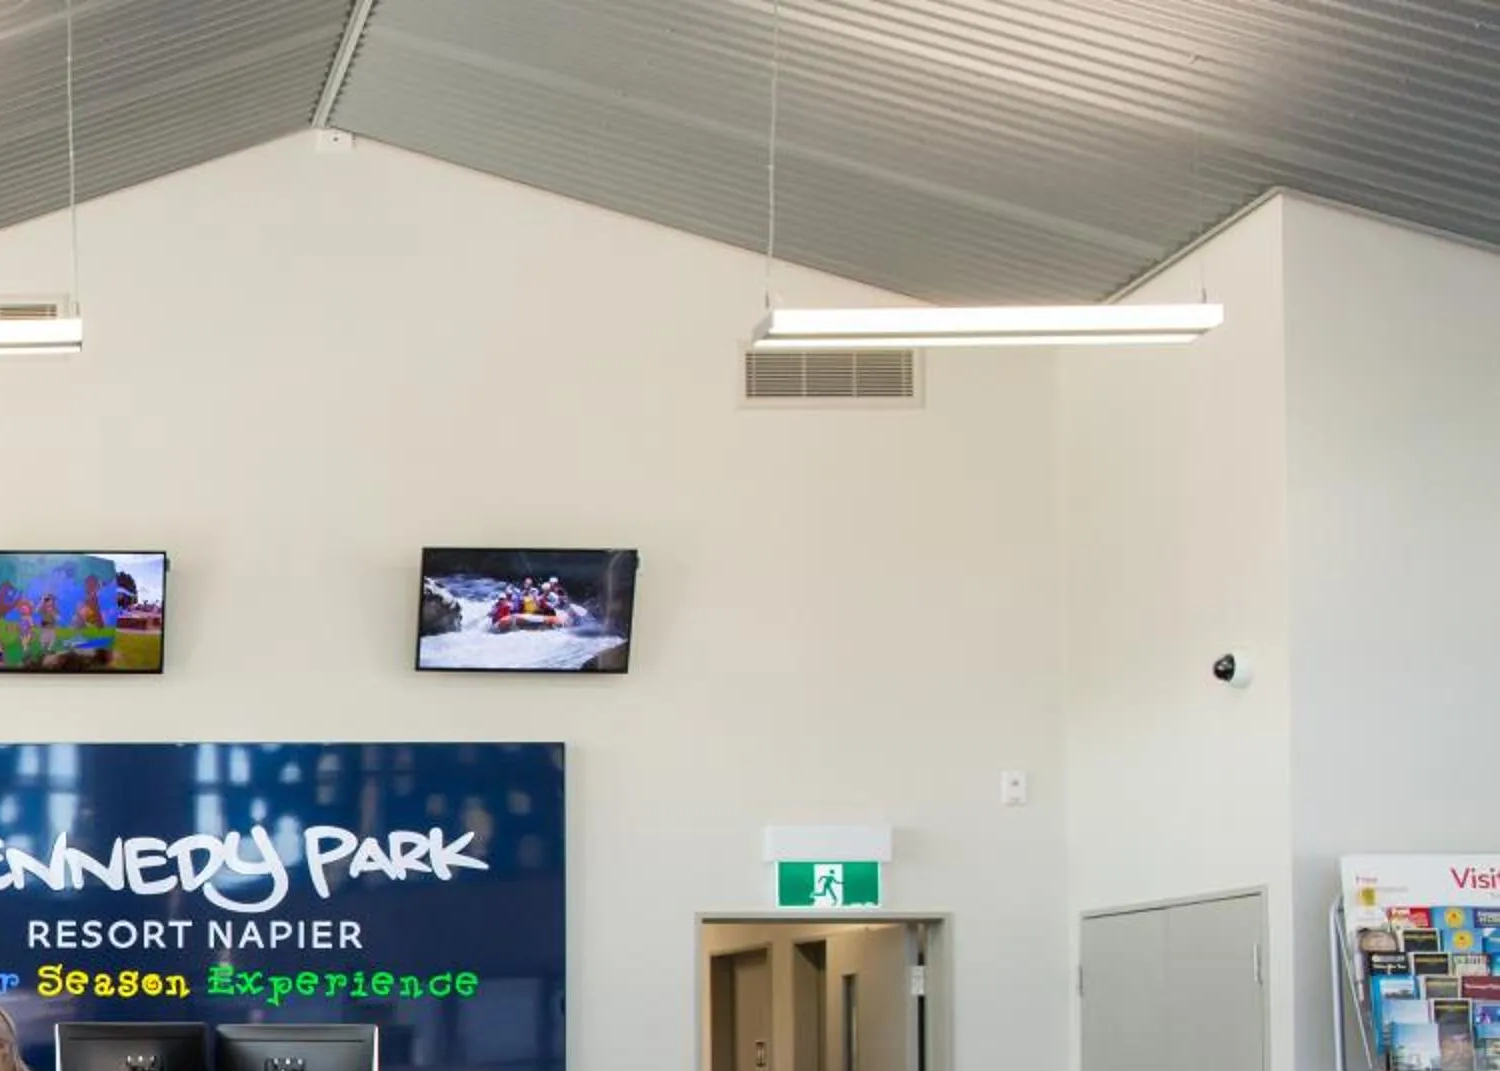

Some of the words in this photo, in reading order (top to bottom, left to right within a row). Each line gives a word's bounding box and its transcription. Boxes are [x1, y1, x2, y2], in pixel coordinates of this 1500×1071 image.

[304, 825, 489, 898] PARK
[1450, 866, 1500, 888] Visi
[27, 920, 192, 949] RESORT
[208, 920, 364, 949] NAPIER
[37, 962, 191, 998] Season
[208, 962, 479, 1006] Experience
